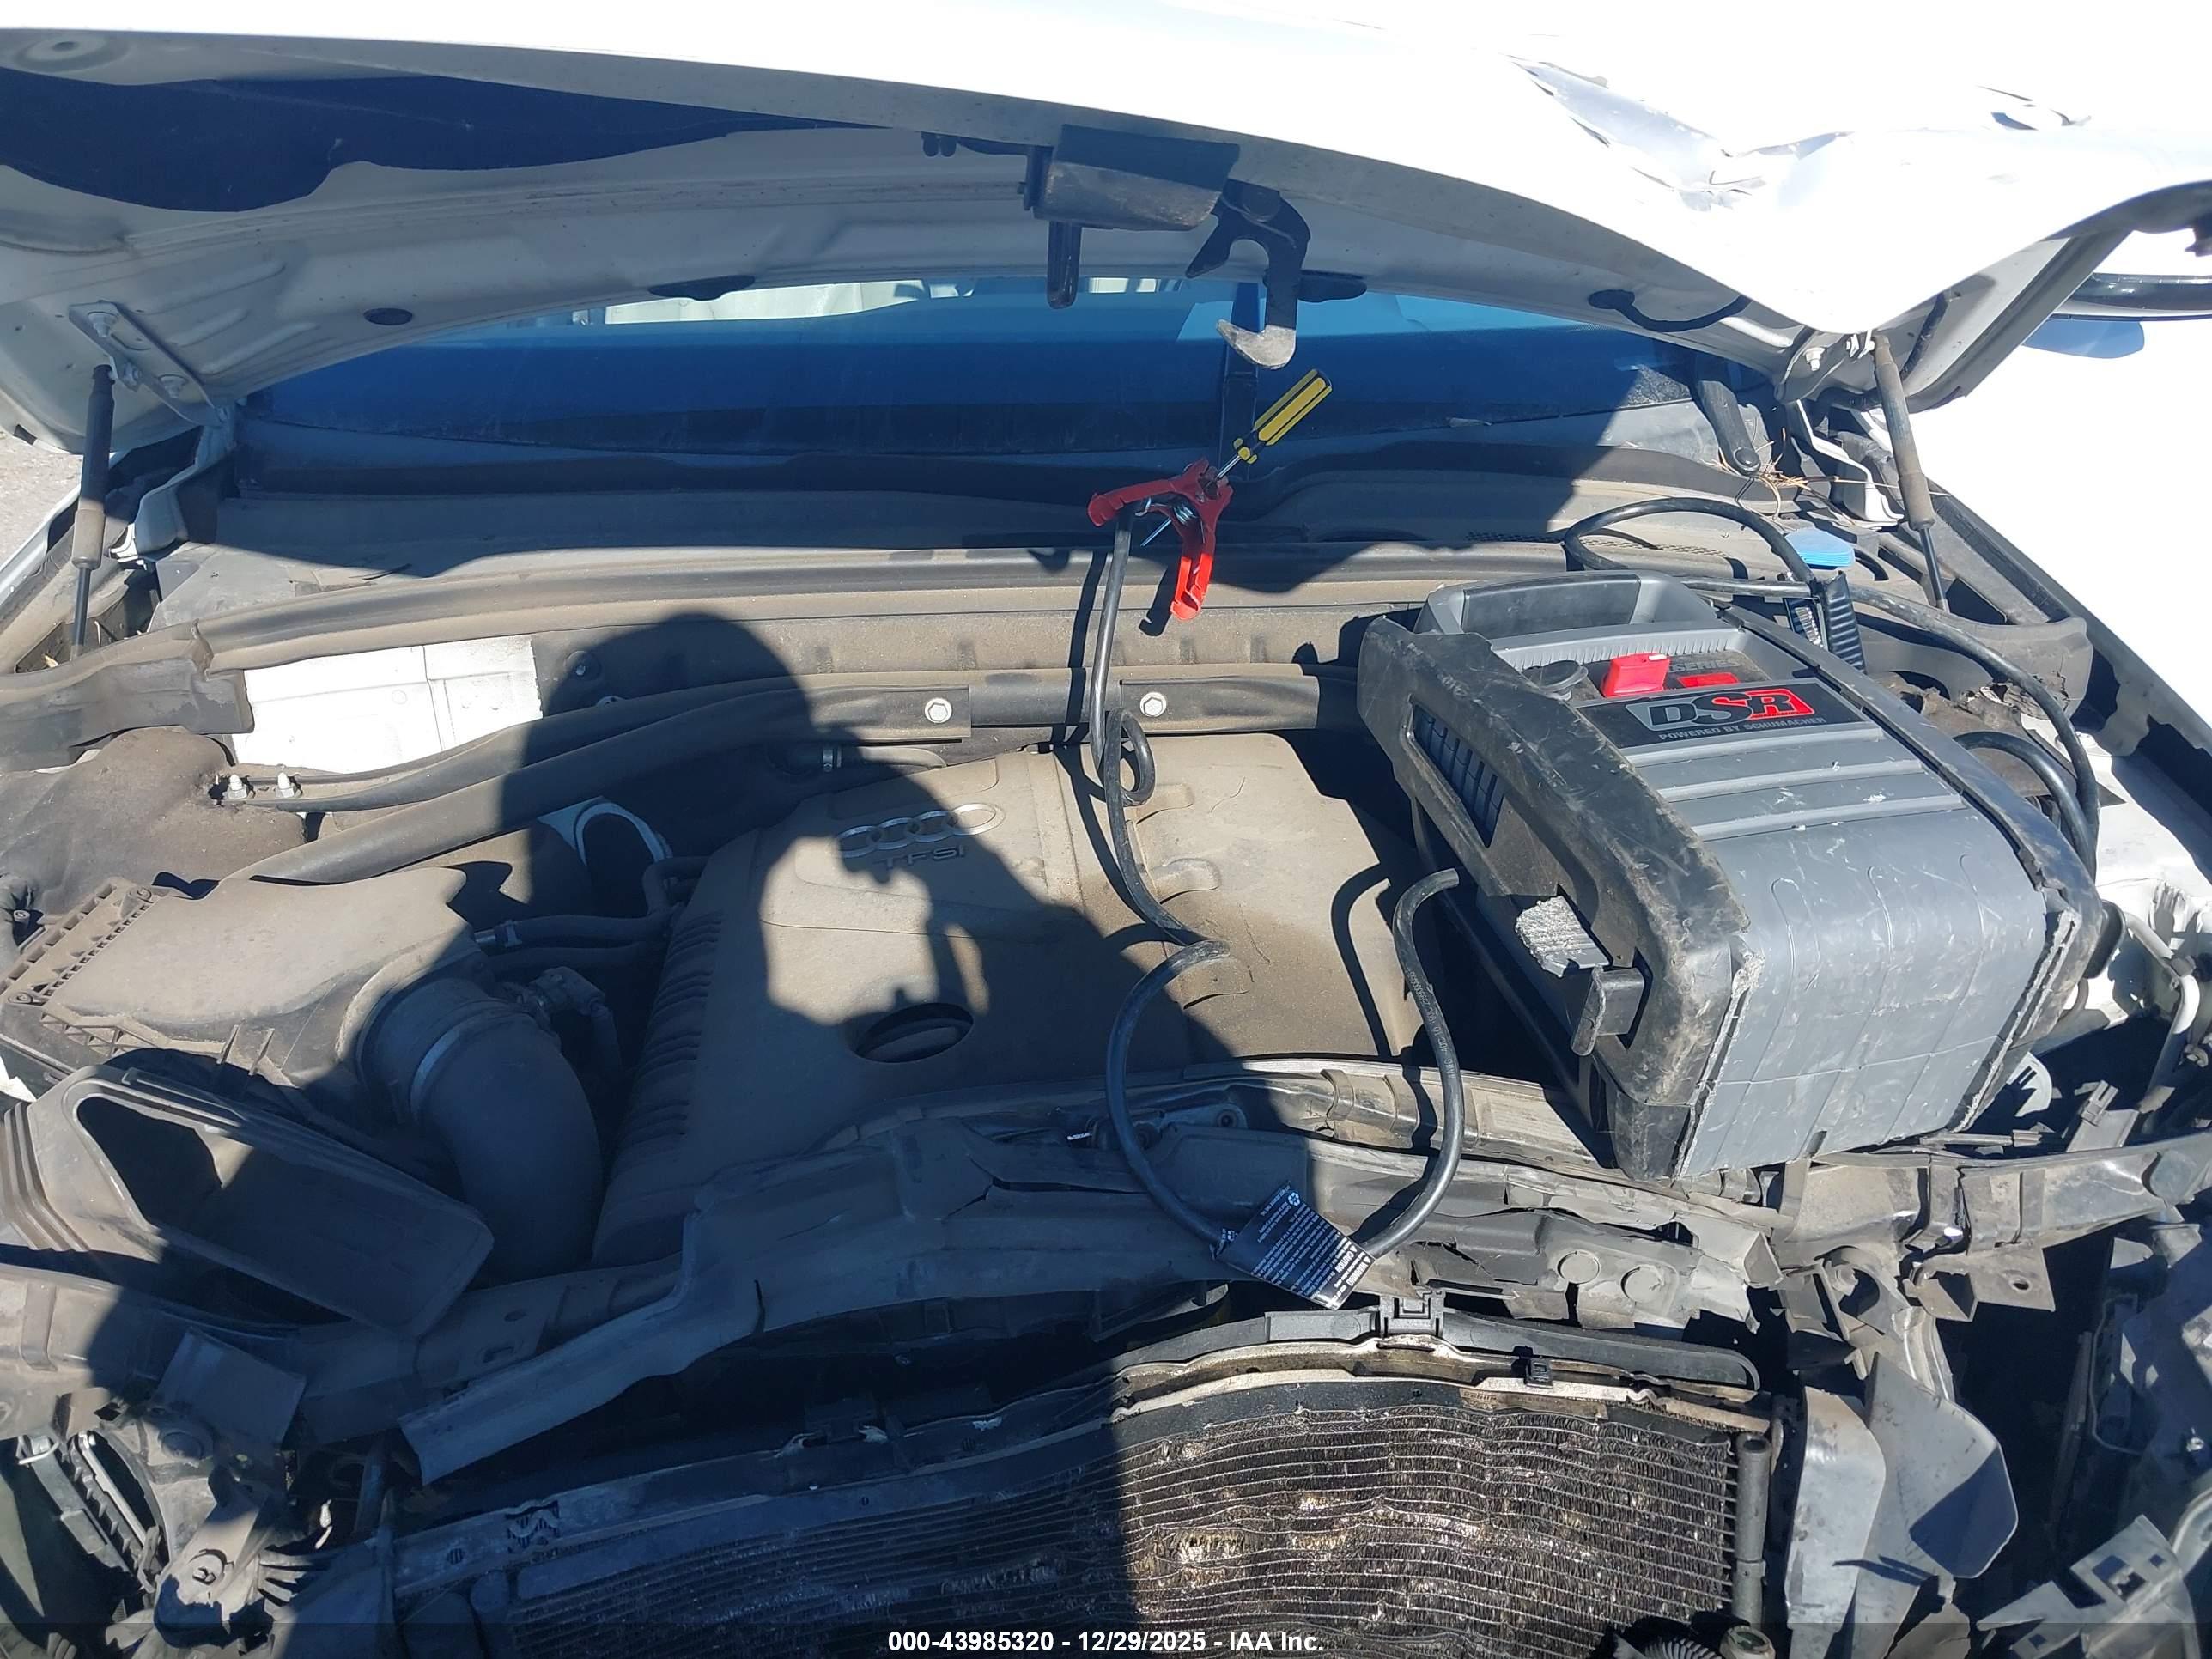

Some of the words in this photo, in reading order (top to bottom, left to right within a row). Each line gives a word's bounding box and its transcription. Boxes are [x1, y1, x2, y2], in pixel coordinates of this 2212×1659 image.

[1649, 691, 1794, 726] DSR
[1659, 727, 1721, 740] POWERED
[1723, 725, 1740, 733] BY
[1744, 717, 1826, 731] SCHUMACHER
[874, 846, 964, 870] TFSI
[1334, 1250, 1355, 1273] CAUTION
[1346, 1261, 1368, 1286] WARNING
